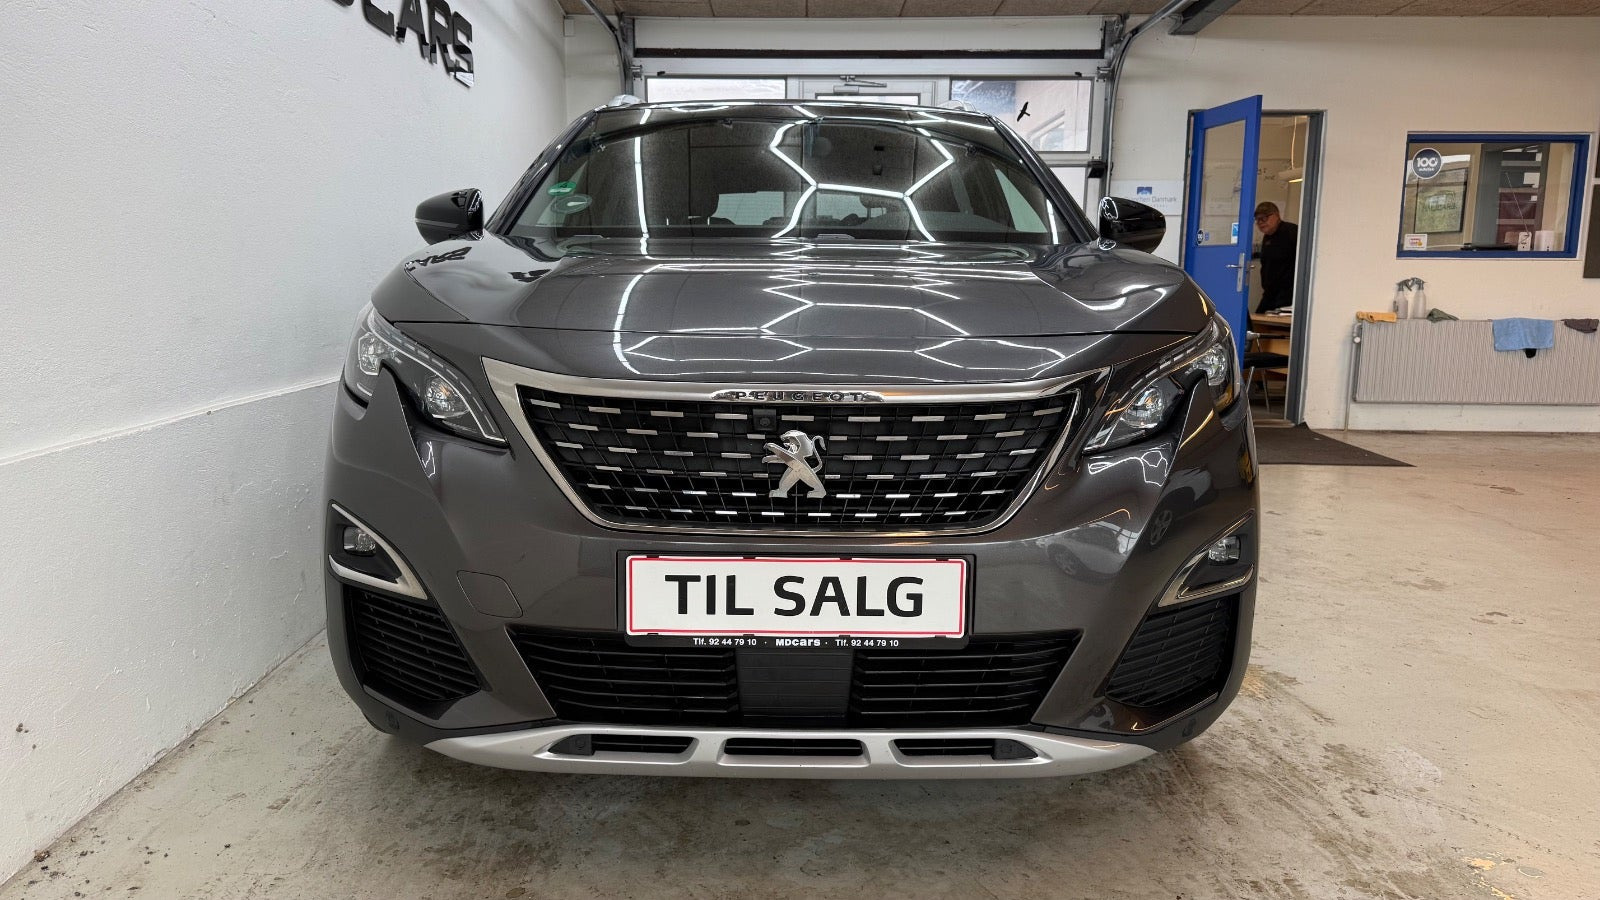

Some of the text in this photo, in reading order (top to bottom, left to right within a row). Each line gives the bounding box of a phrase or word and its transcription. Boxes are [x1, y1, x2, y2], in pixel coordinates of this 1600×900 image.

[735, 390, 864, 402] PEUGEOT
[664, 574, 924, 618] TIL SALG
[692, 637, 899, 647] Tlf. 92 44 79 10 MDcars Tlf. 92 44 79 10
